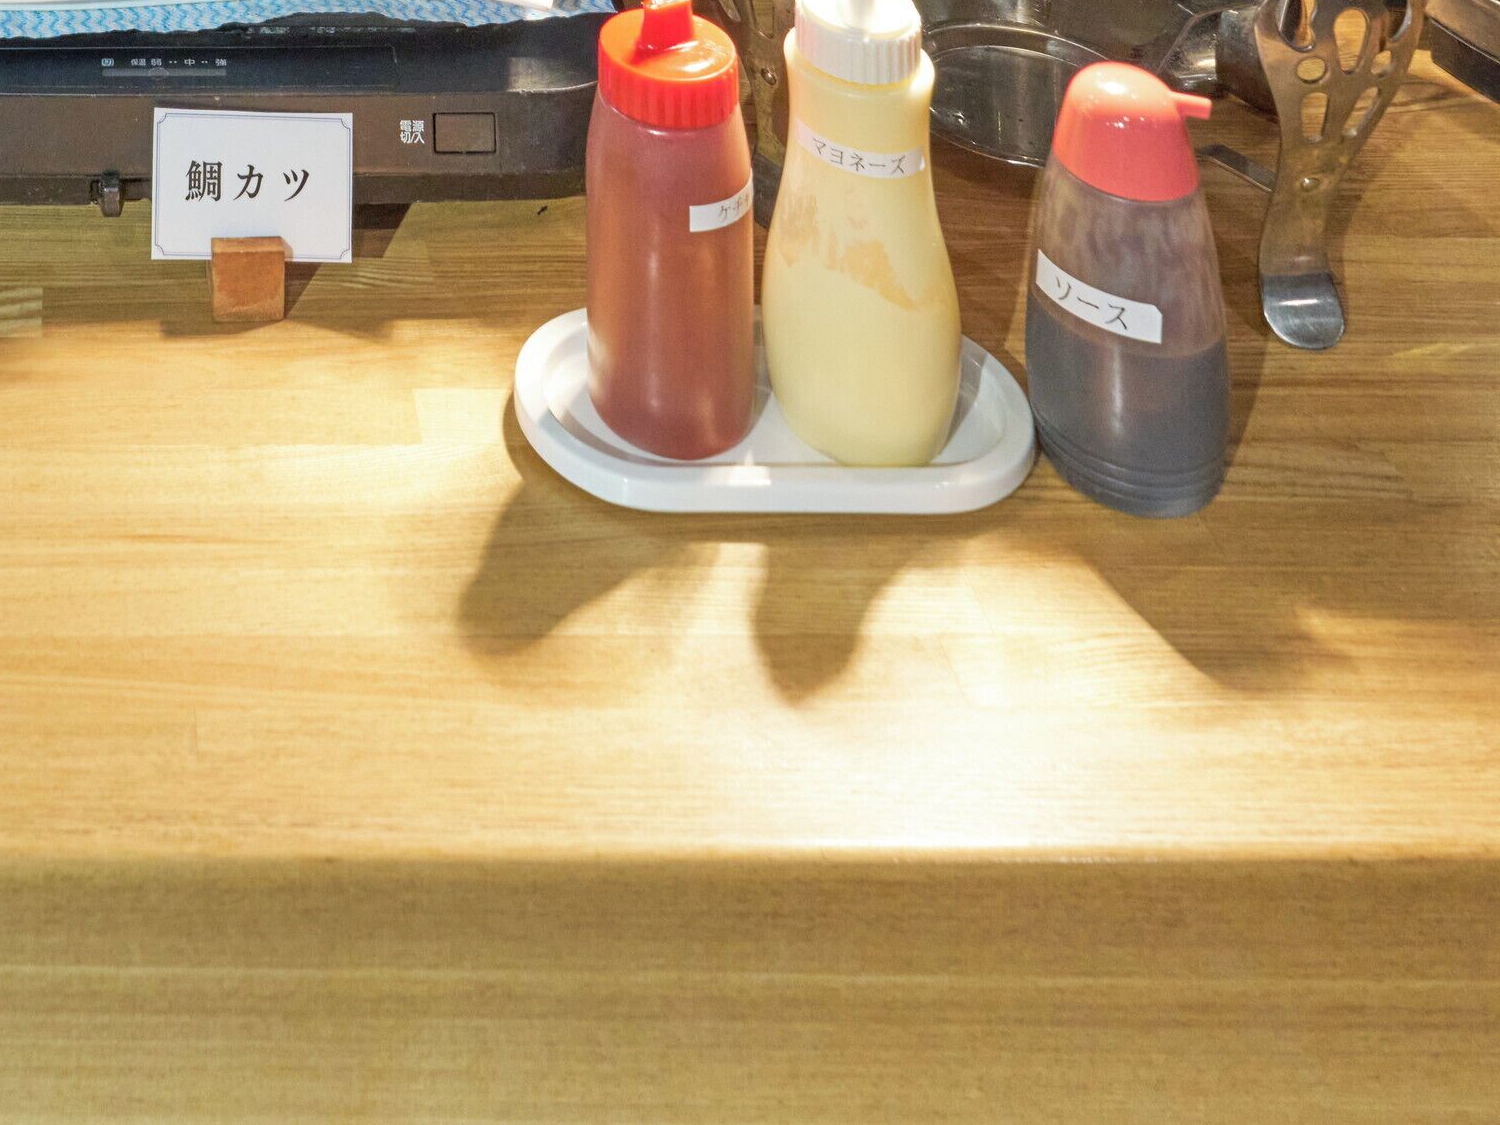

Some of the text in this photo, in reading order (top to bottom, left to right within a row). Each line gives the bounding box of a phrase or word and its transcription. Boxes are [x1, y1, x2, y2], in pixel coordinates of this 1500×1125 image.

[400, 119, 425, 132] 電源
[185, 160, 310, 202] 鯛カツ
[1055, 276, 1128, 330] ソース
